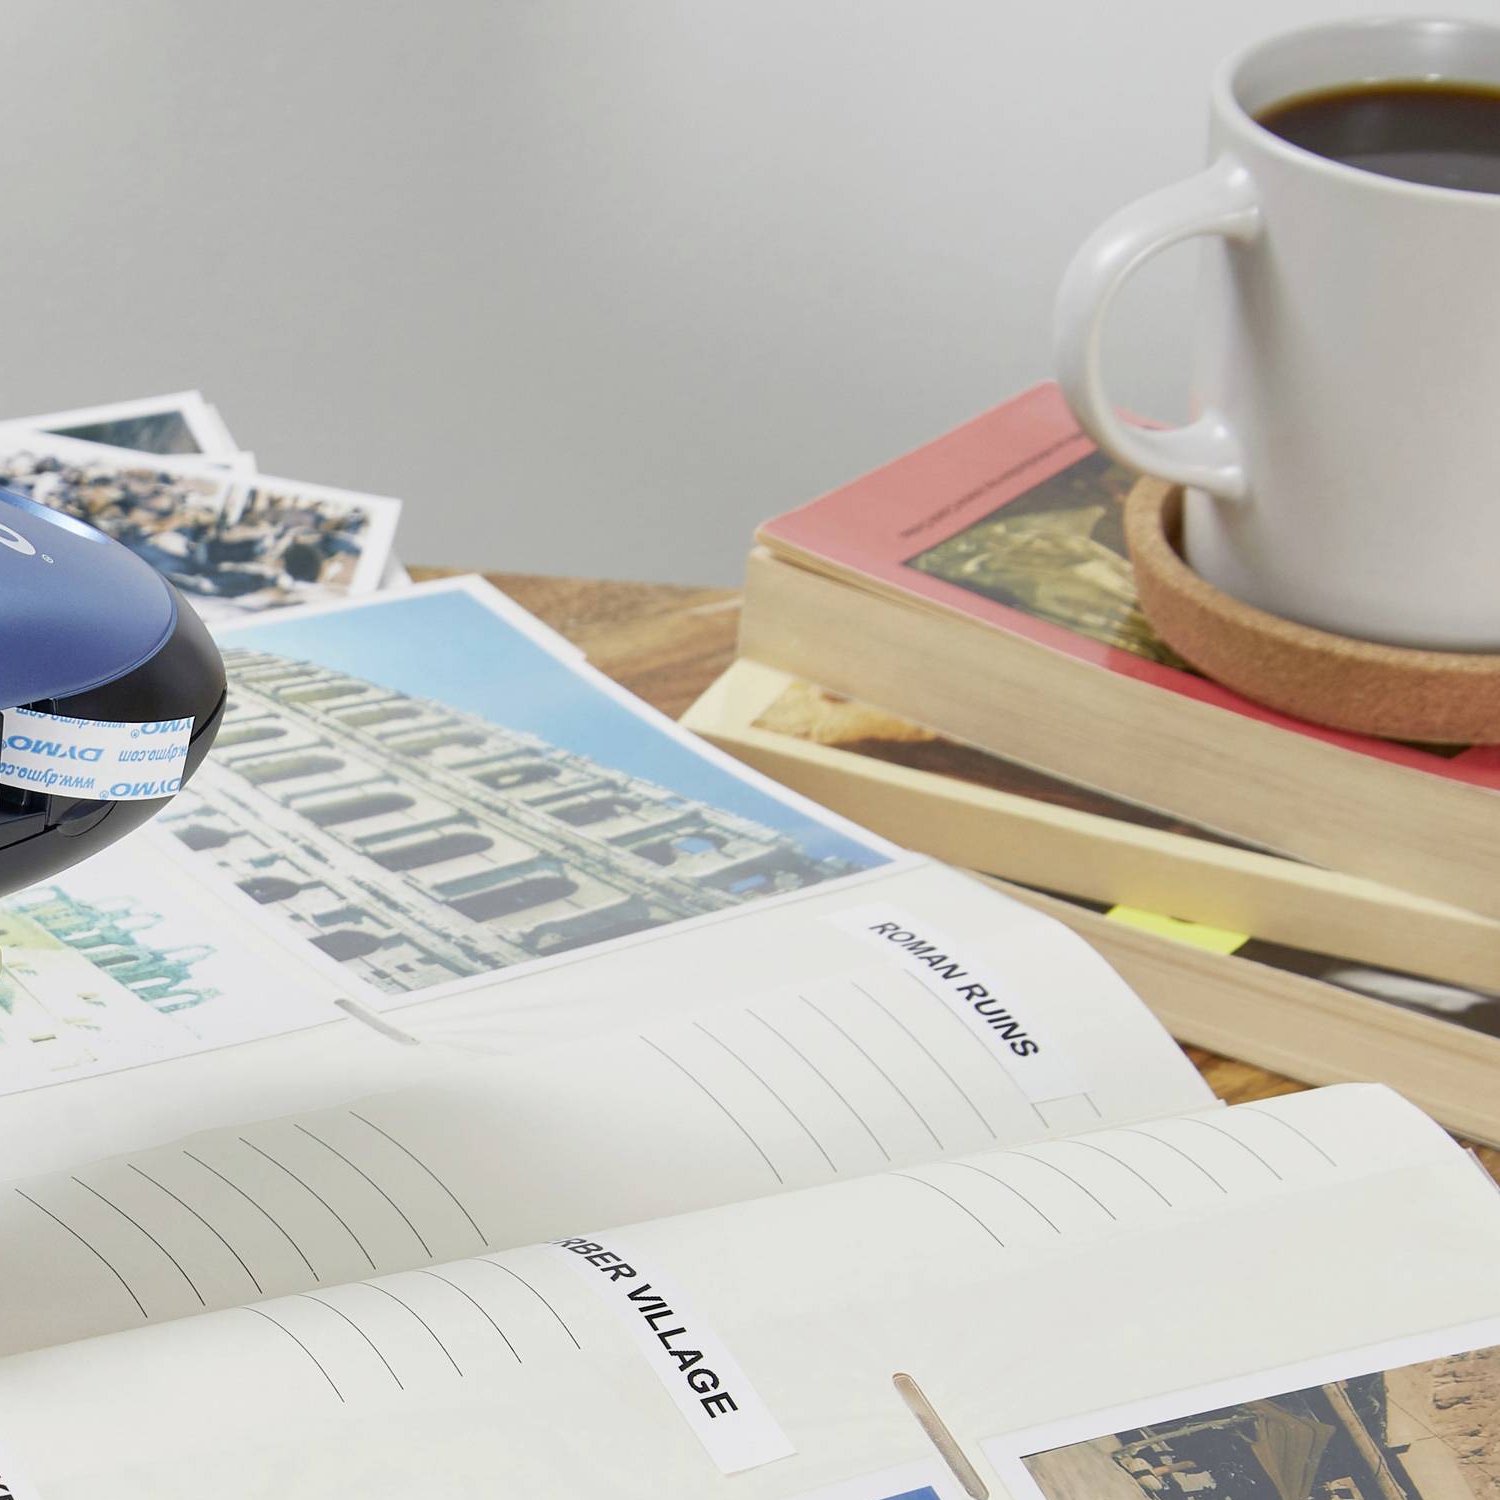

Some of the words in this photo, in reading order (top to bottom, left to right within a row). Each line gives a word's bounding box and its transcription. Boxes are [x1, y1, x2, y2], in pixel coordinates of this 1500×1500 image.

[140, 718, 192, 735] YMO
[7, 735, 104, 762] DYMO
[0, 762, 95, 789] www.dymo.co
[109, 778, 182, 797] DYMO
[868, 921, 968, 980] ROMAN
[956, 983, 1040, 1058] RUINS
[552, 1237, 638, 1283] RBER
[627, 1283, 739, 1419] VILLAGE
